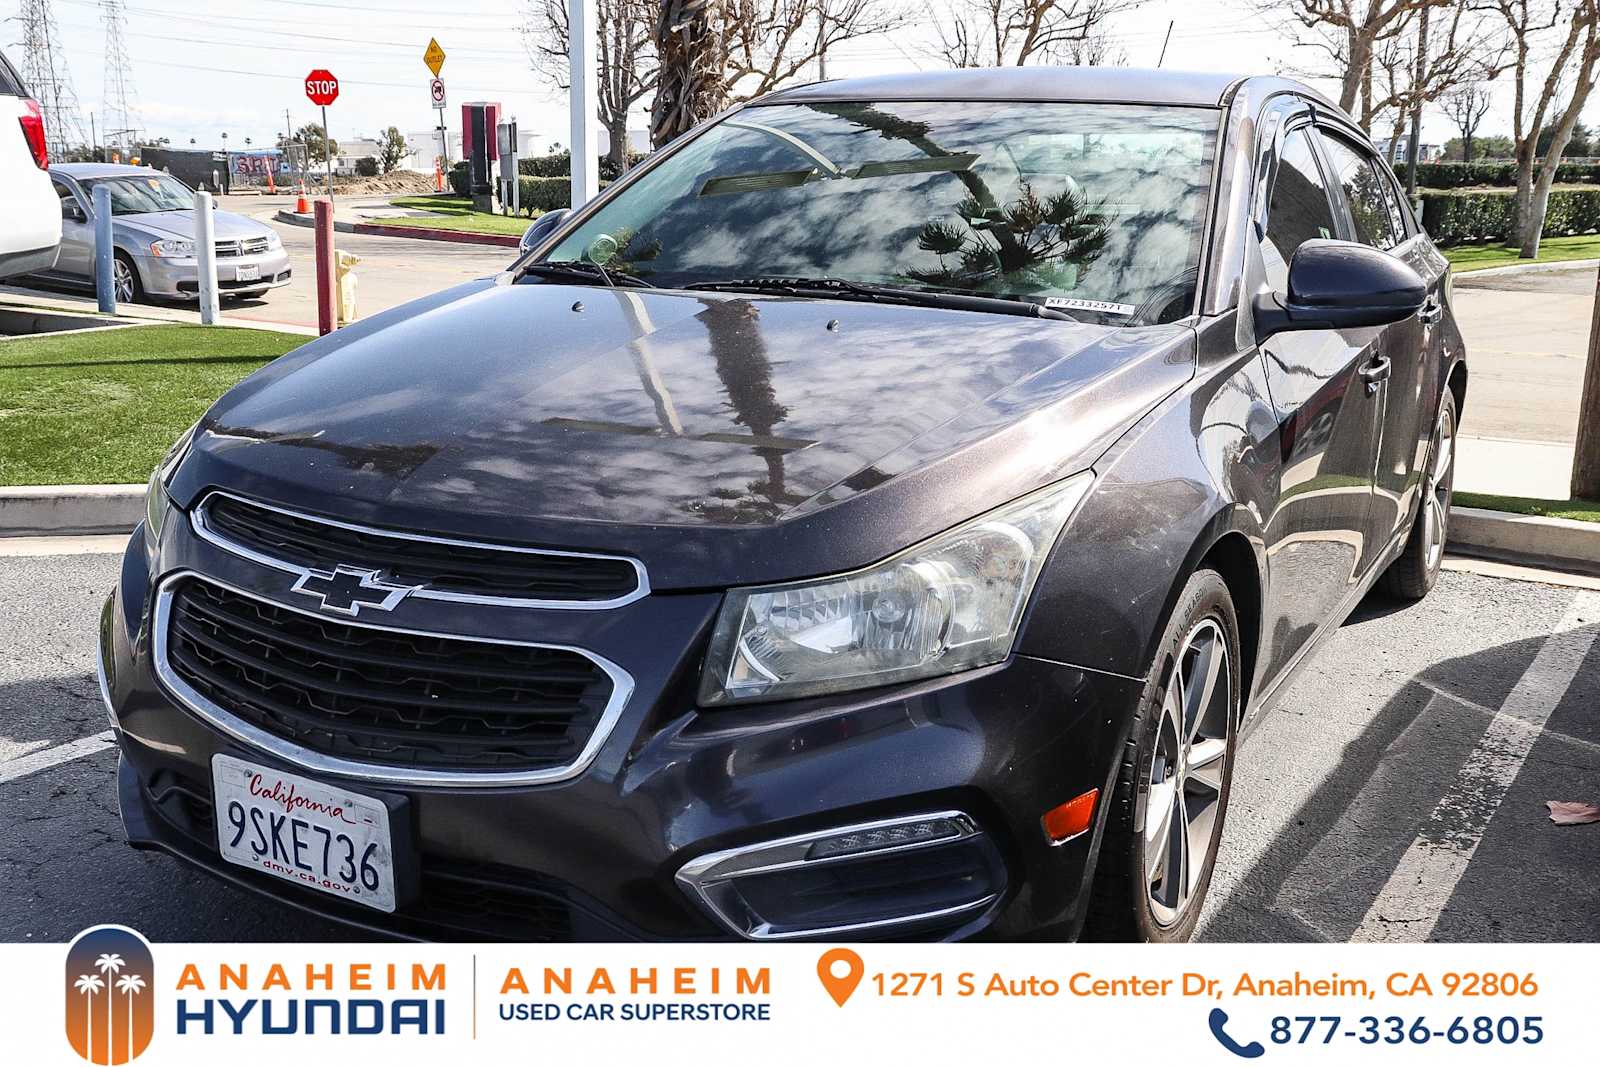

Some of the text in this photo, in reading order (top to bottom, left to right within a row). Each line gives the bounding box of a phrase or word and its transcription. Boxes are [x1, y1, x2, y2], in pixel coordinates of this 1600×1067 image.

[306, 81, 337, 95] STOP
[249, 773, 356, 825] California
[227, 800, 381, 892] 9SKE736
[263, 859, 352, 893] dmv.ca.gov
